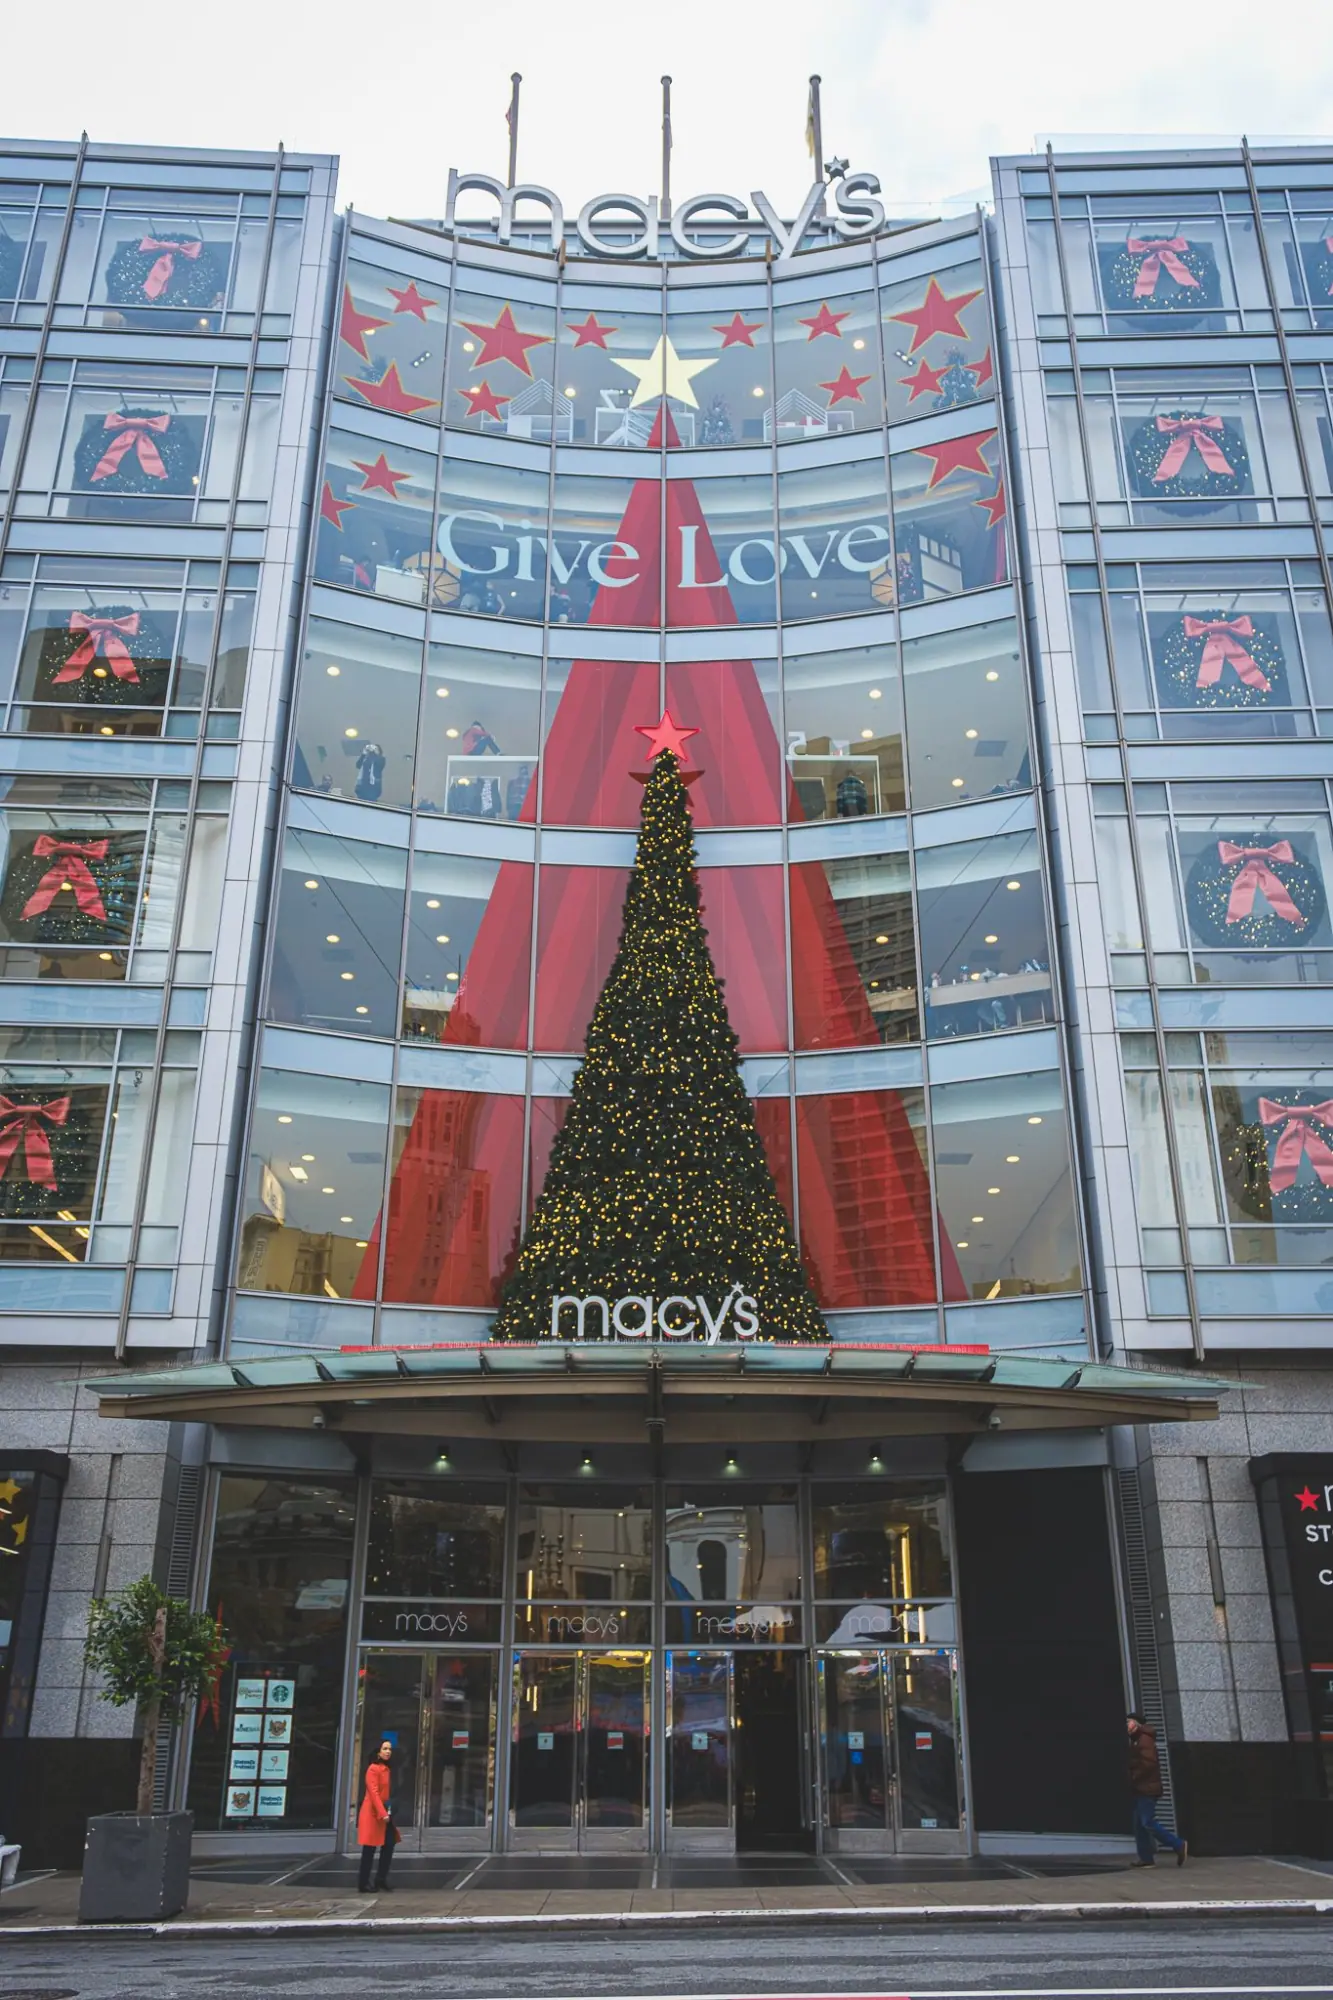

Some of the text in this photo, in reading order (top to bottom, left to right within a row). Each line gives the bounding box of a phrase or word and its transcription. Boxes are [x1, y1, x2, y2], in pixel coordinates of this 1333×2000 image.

[443, 156, 888, 261] macy's
[437, 510, 891, 589] Give Love
[551, 1281, 760, 1346] macy's
[395, 1611, 468, 1637] macy's
[547, 1613, 619, 1638] macy's
